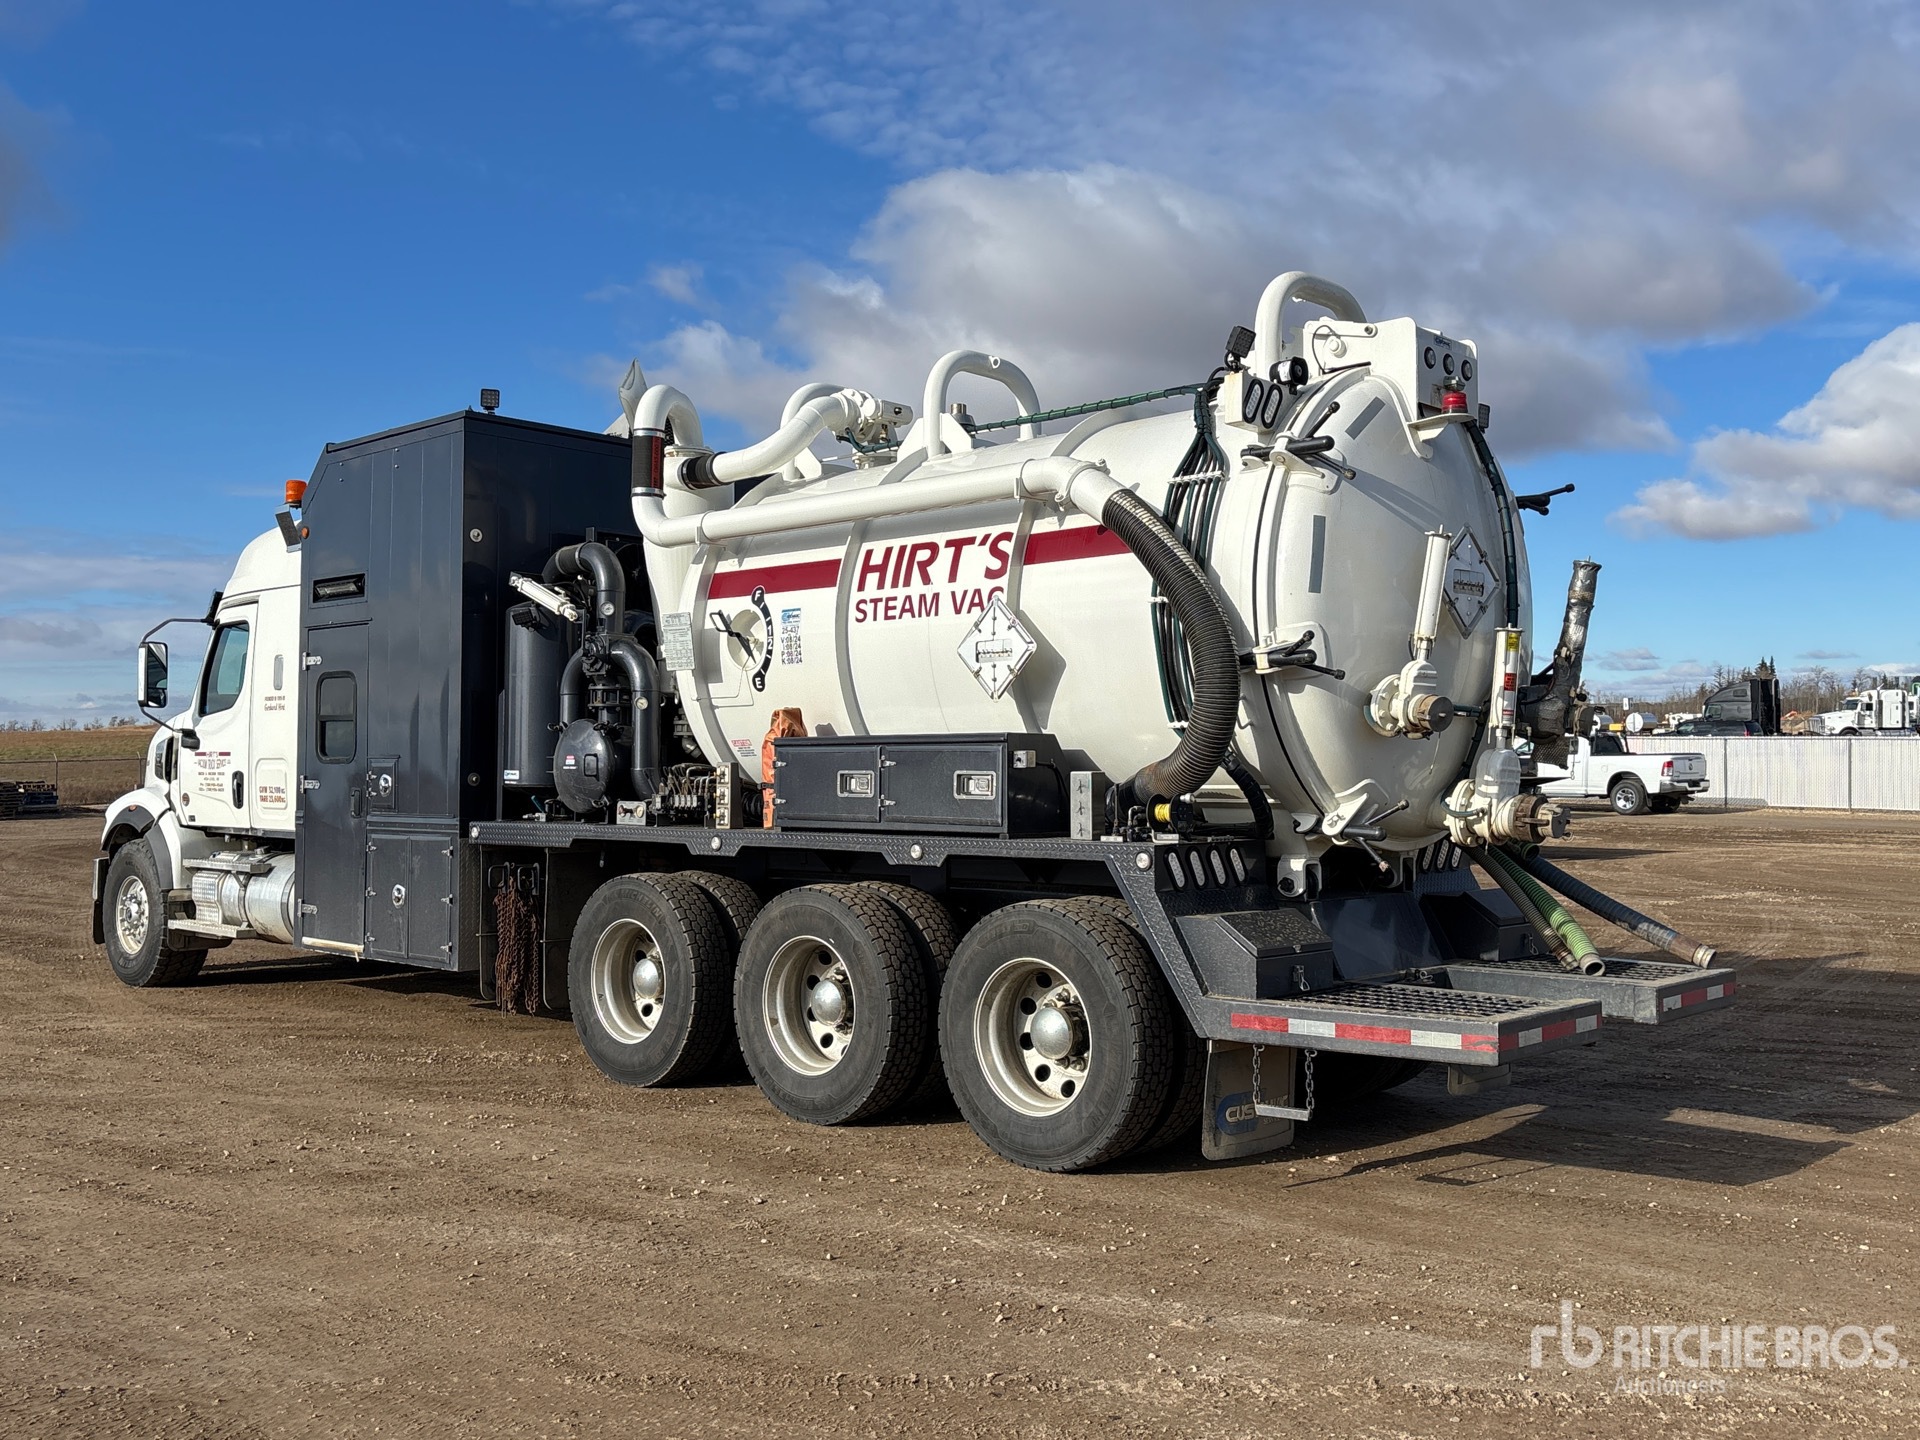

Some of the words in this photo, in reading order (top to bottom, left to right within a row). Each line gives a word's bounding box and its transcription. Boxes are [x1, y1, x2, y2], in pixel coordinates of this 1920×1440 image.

[857, 531, 1014, 592] HIRT'S
[754, 590, 762, 601] F
[855, 592, 940, 624] STEAM
[767, 624, 772, 635] 1
[767, 639, 773, 650] 2
[754, 677, 763, 688] E
